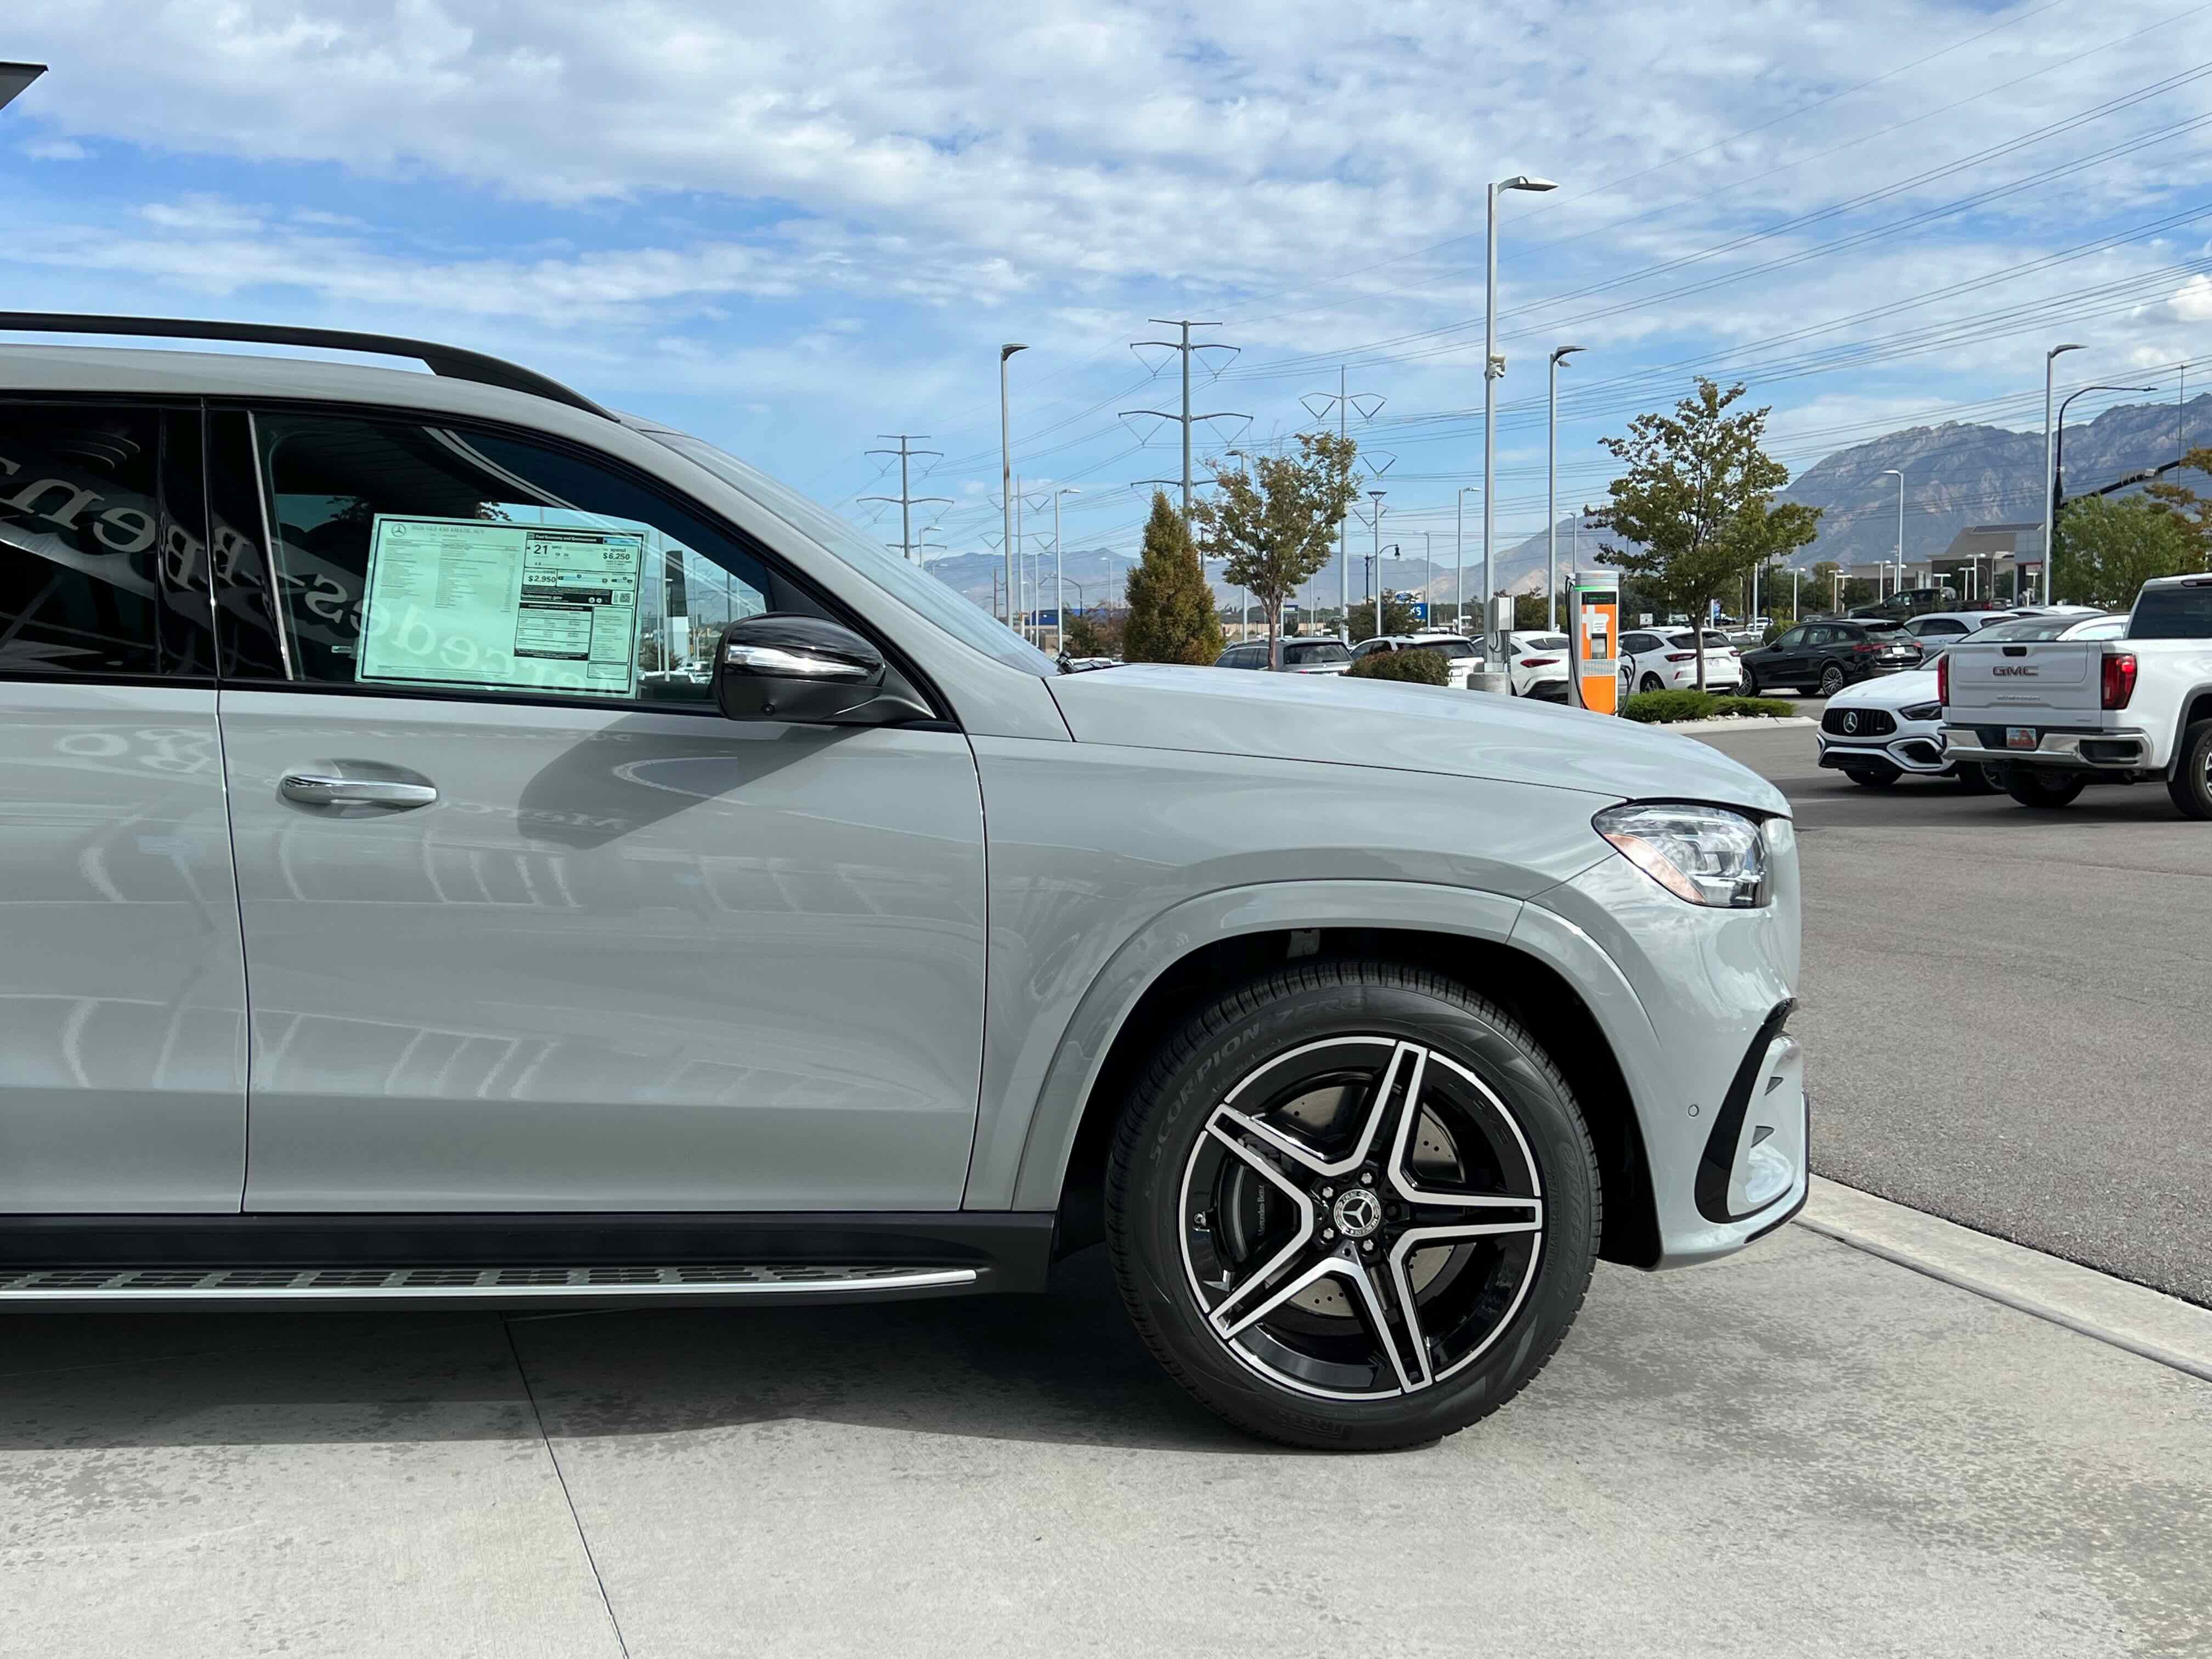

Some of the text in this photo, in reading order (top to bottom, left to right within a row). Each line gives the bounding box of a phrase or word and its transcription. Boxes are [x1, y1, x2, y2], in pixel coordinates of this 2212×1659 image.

[533, 544, 548, 555] 21
[1993, 665, 2039, 676] GMC
[1150, 1022, 1261, 1167] SCORPION
